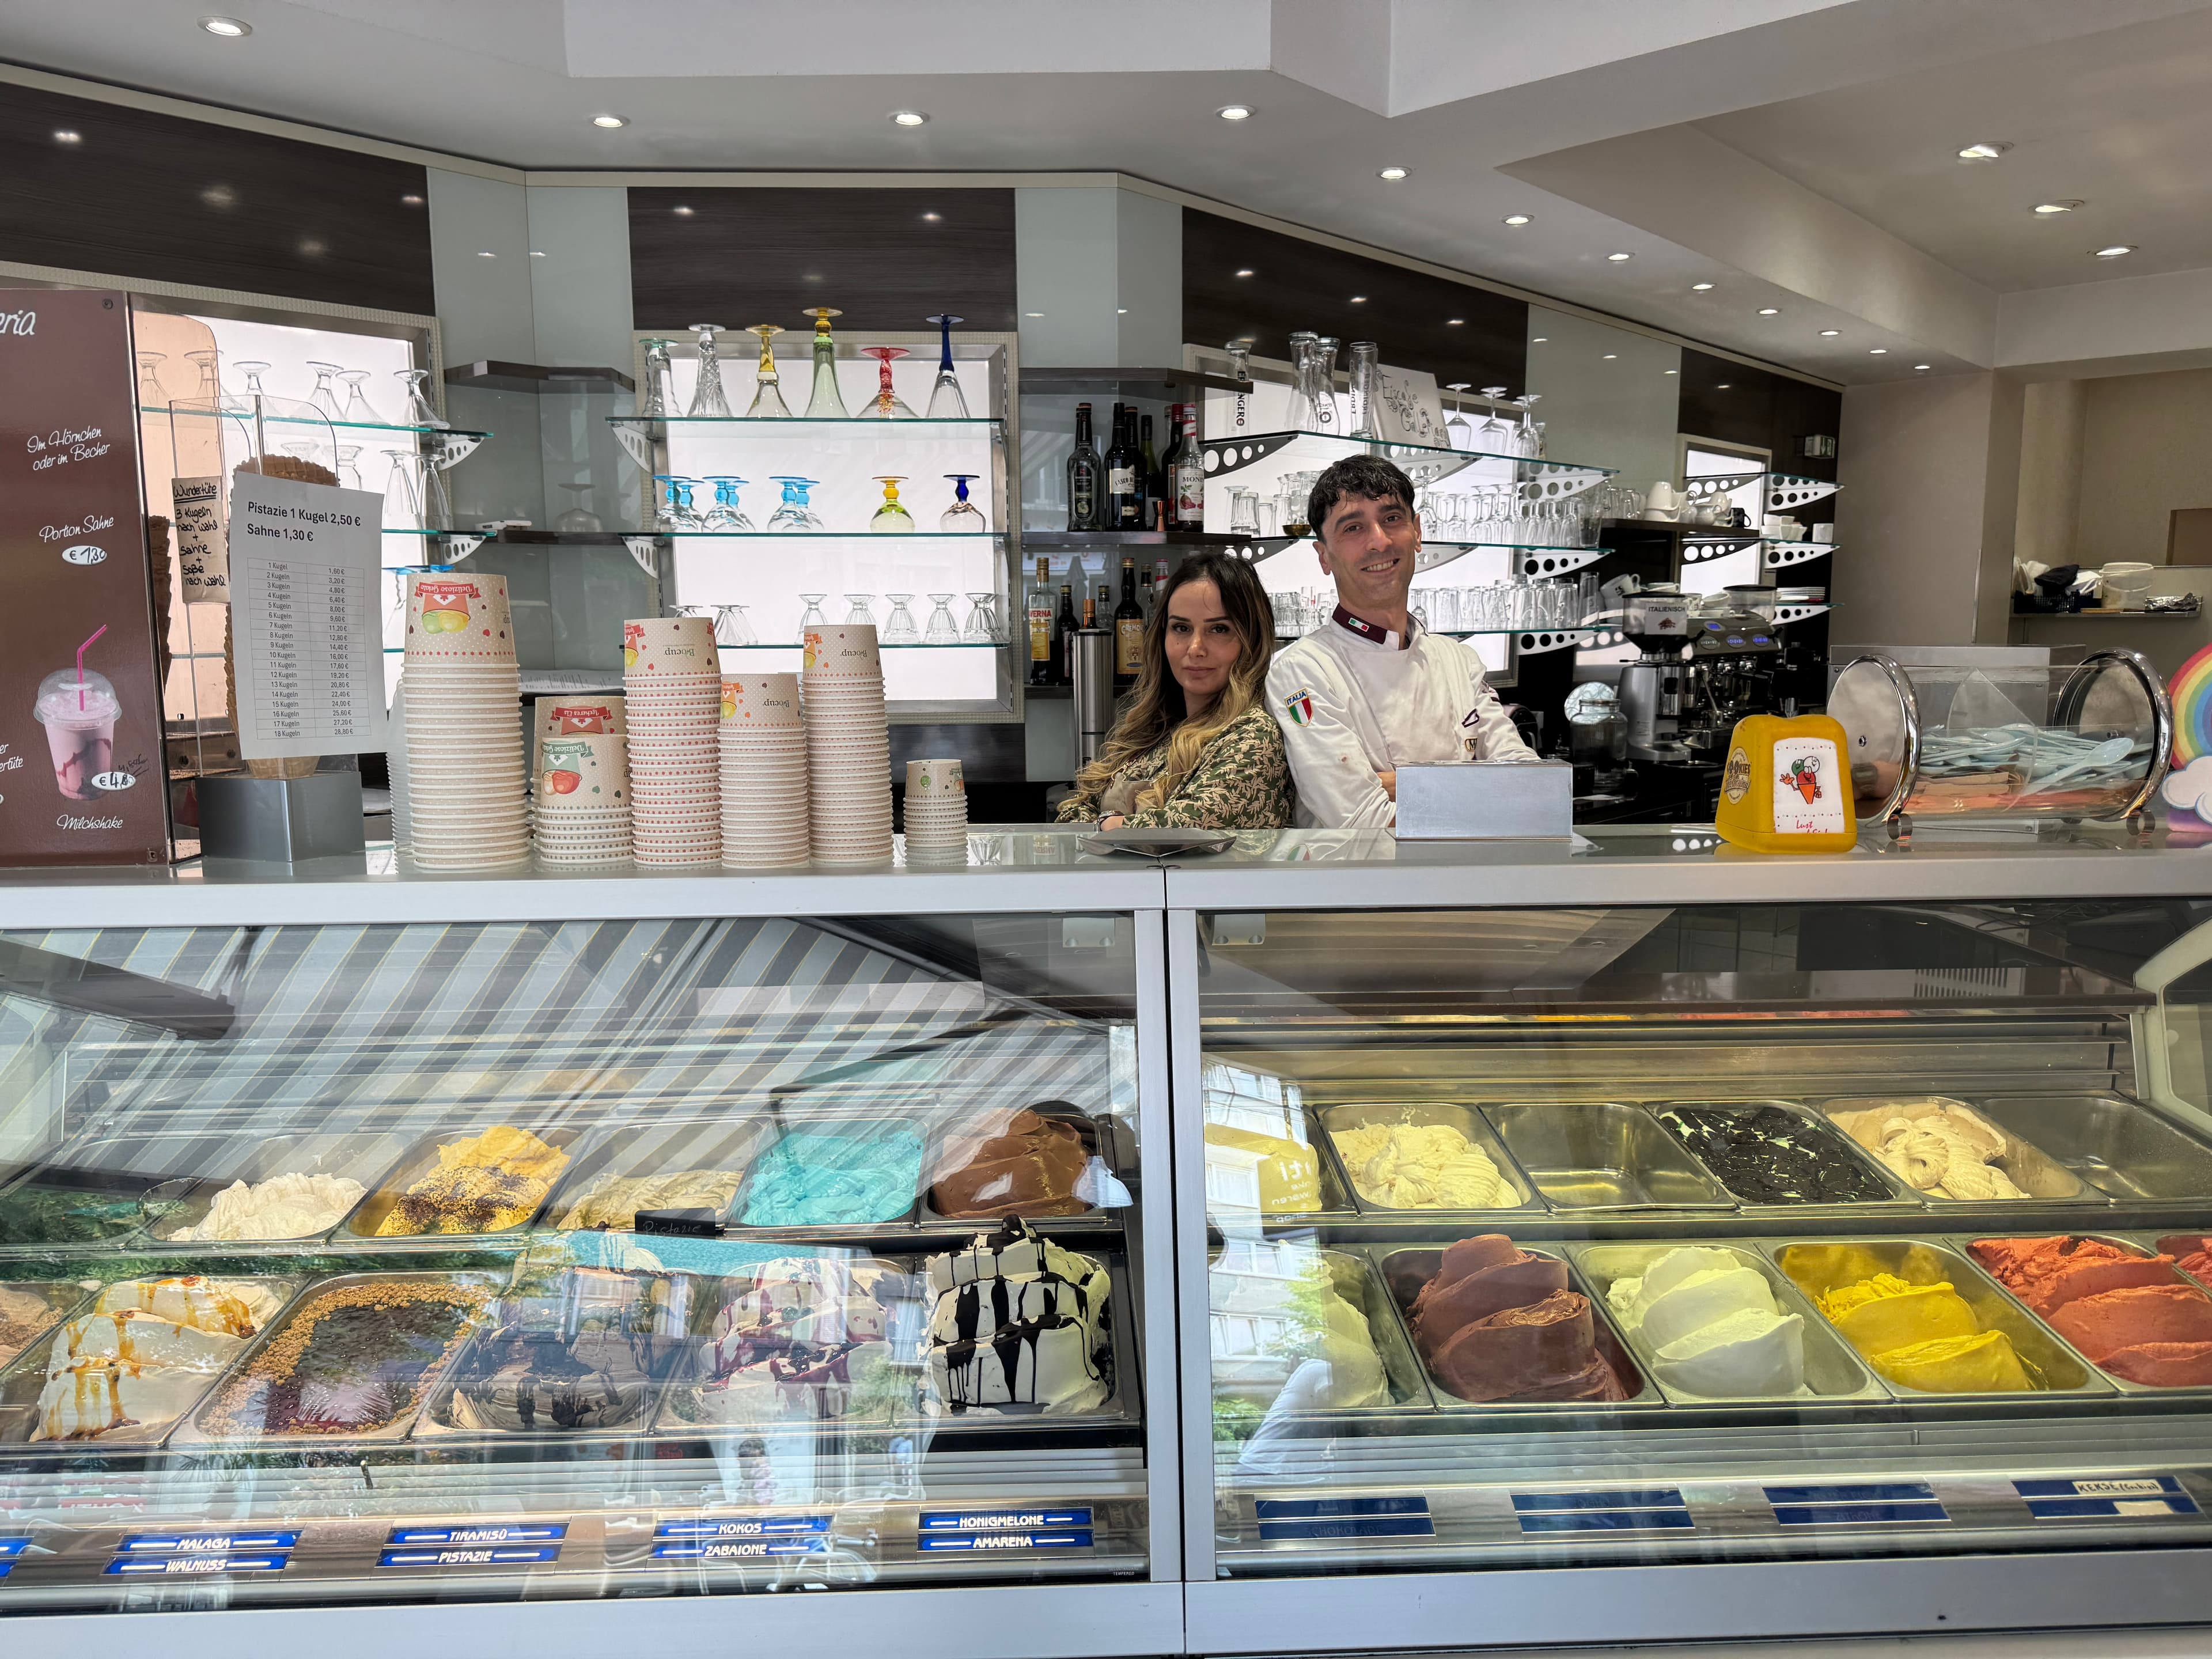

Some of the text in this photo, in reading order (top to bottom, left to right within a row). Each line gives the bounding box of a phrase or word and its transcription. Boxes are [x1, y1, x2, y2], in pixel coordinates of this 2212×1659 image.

[28, 425, 101, 453] Im Hörnchen
[33, 442, 111, 471] oder im Becher
[176, 506, 211, 523] 3 Kugeln
[248, 501, 361, 527] Pistazie 1 Kugel 2,50 €
[39, 515, 114, 543] Portion Sahne
[177, 523, 195, 532] nach
[247, 523, 313, 541] Sahne 1,30 €
[69, 550, 77, 560] €
[272, 573, 290, 581] Kugeln
[1286, 690, 1307, 706] ITALIA
[554, 745, 585, 753] Delizioso
[99, 777, 106, 786] €
[56, 814, 123, 830] Milchshake
[1796, 820, 1813, 830] Lust
[718, 1522, 762, 1534] KOKOS
[959, 1515, 1044, 1528] HONIGMELONE
[176, 1538, 230, 1550] MALAGA
[972, 1536, 1033, 1548] AMARENA
[438, 1550, 493, 1563] PISTAZIE
[704, 1544, 767, 1556] ZABAIONE
[166, 1559, 228, 1572] WALNUSS
